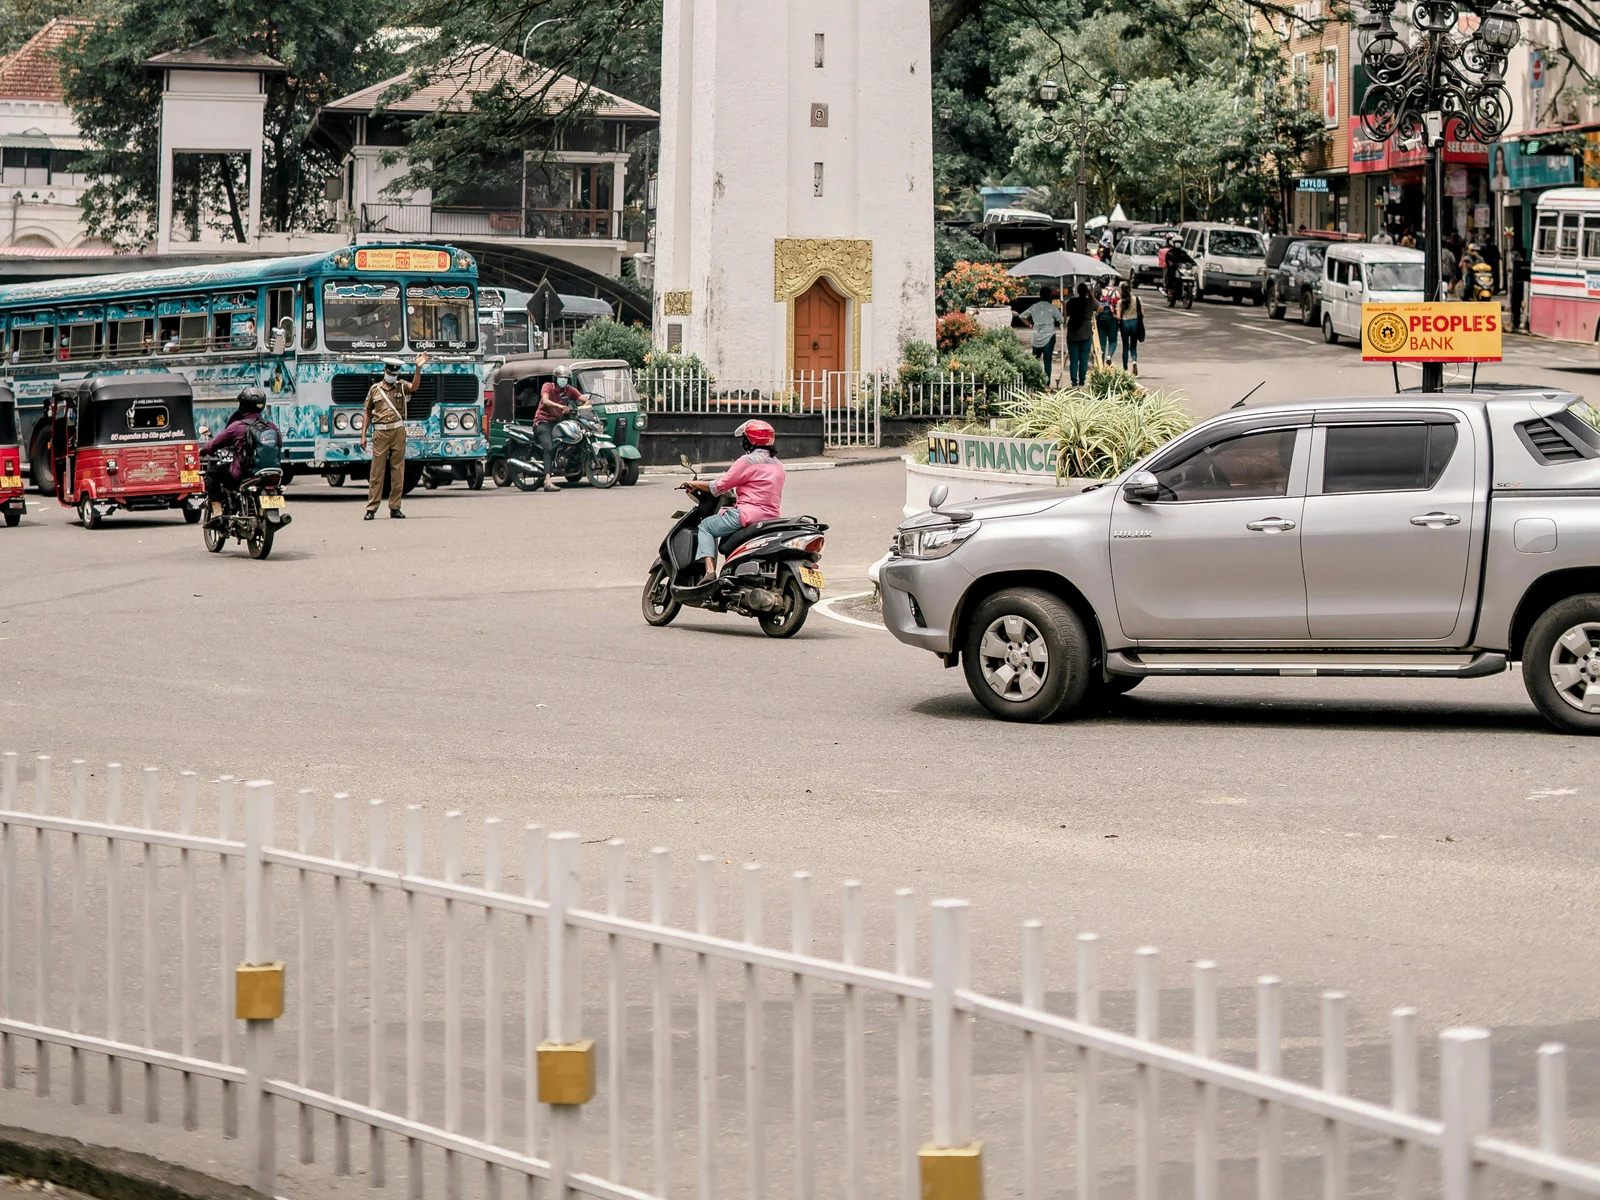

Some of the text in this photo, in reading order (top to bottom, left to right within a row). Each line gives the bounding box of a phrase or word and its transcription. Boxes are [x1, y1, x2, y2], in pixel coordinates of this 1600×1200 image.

[1300, 179, 1327, 188] CEYLON
[1409, 315, 1497, 332] PEOPLE'S
[1410, 336, 1454, 351] BANK
[928, 437, 1058, 472] HNB FINANCE
[1113, 530, 1153, 538] HILUX
